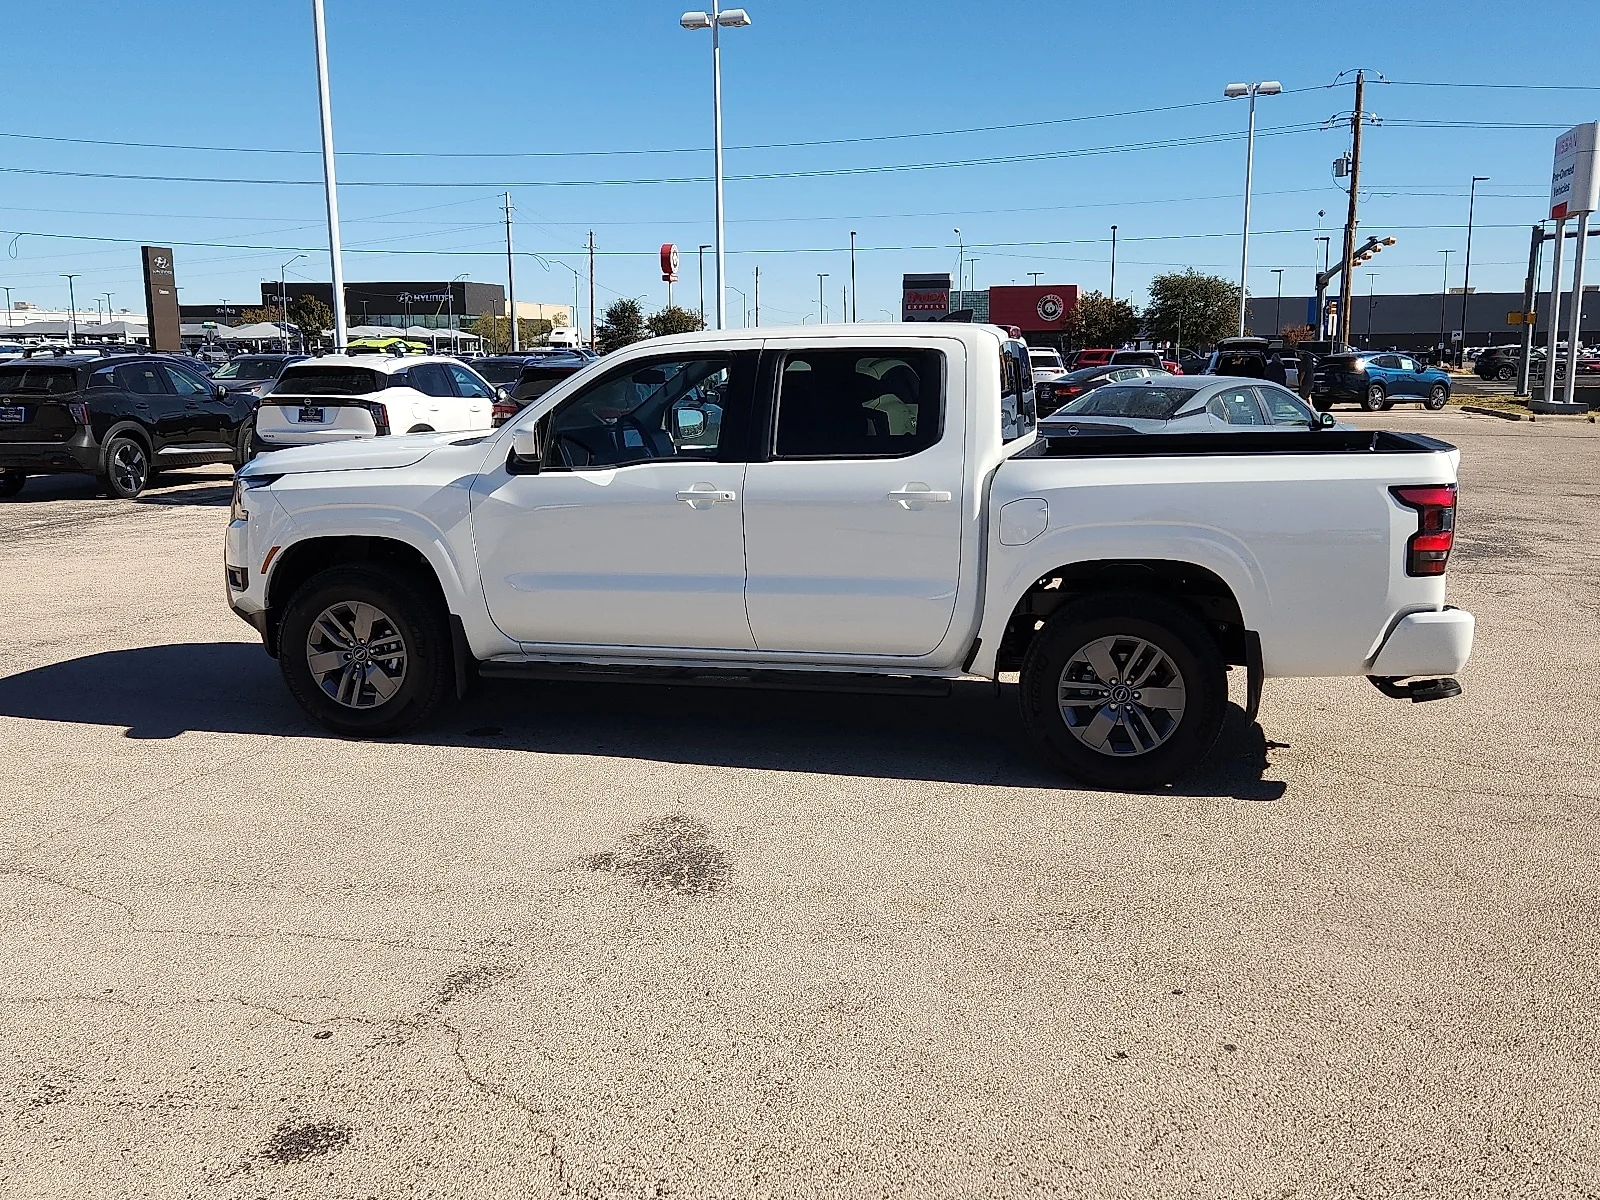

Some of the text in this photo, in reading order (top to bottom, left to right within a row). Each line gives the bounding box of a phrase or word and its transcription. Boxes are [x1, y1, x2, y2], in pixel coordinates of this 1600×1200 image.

[1552, 163, 1575, 183] Pre-Owned
[1553, 182, 1570, 197] Vehicles
[413, 294, 454, 302] HYUNDAI
